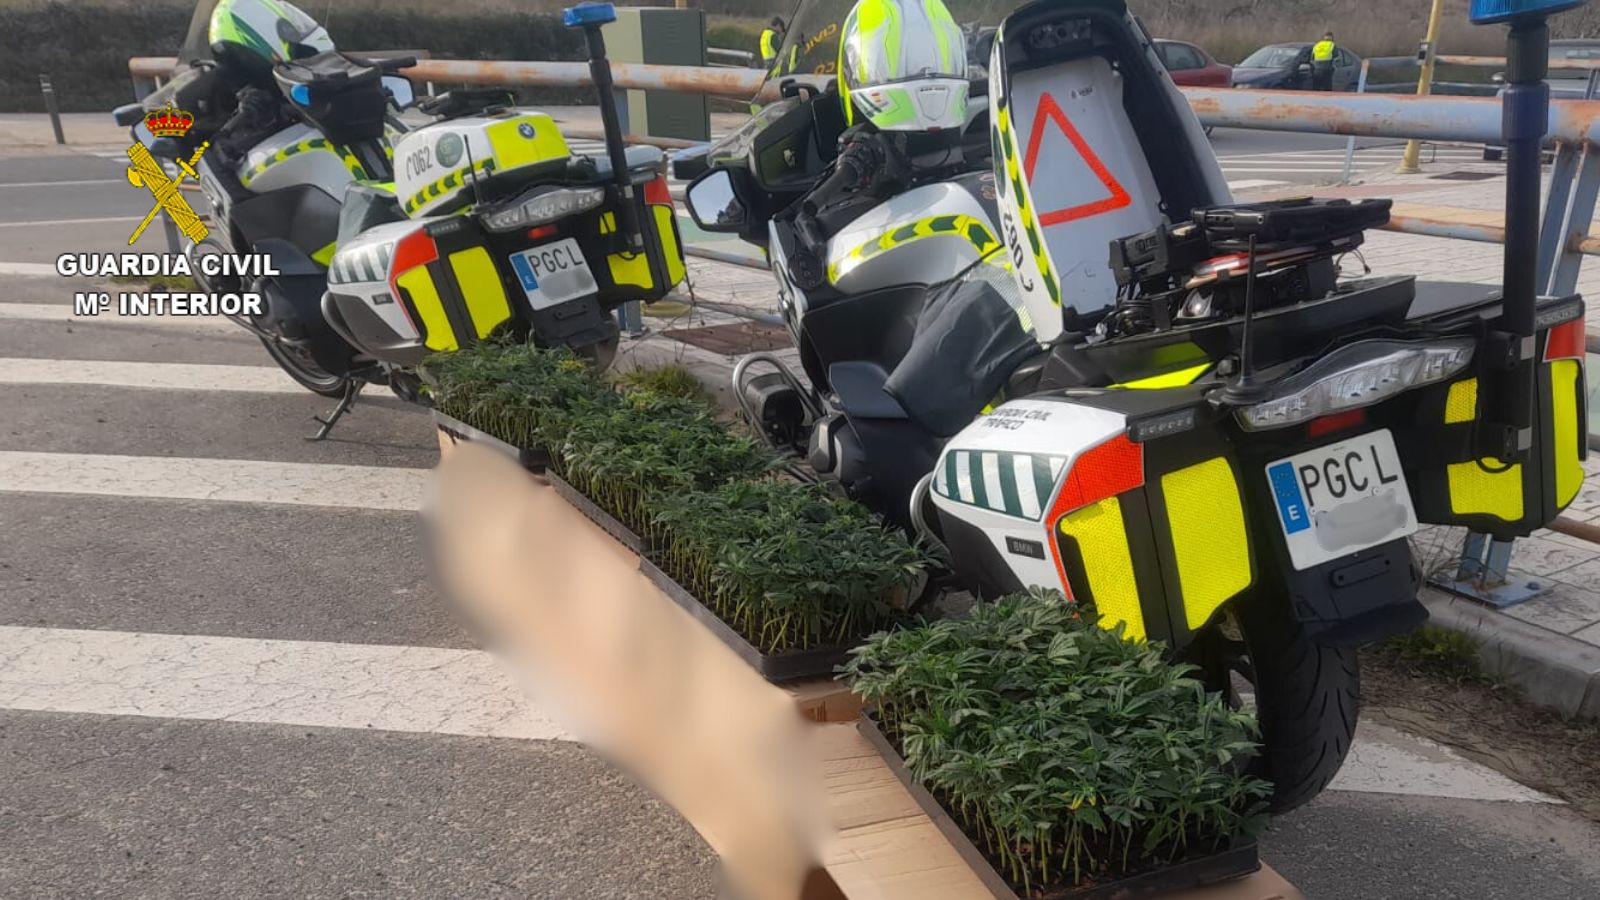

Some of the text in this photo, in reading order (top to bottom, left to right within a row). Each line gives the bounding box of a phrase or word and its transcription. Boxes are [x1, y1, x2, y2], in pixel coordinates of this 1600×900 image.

[528, 248, 568, 277] PGC
[1299, 445, 1398, 507] PGC L
[1288, 505, 1300, 520] E
